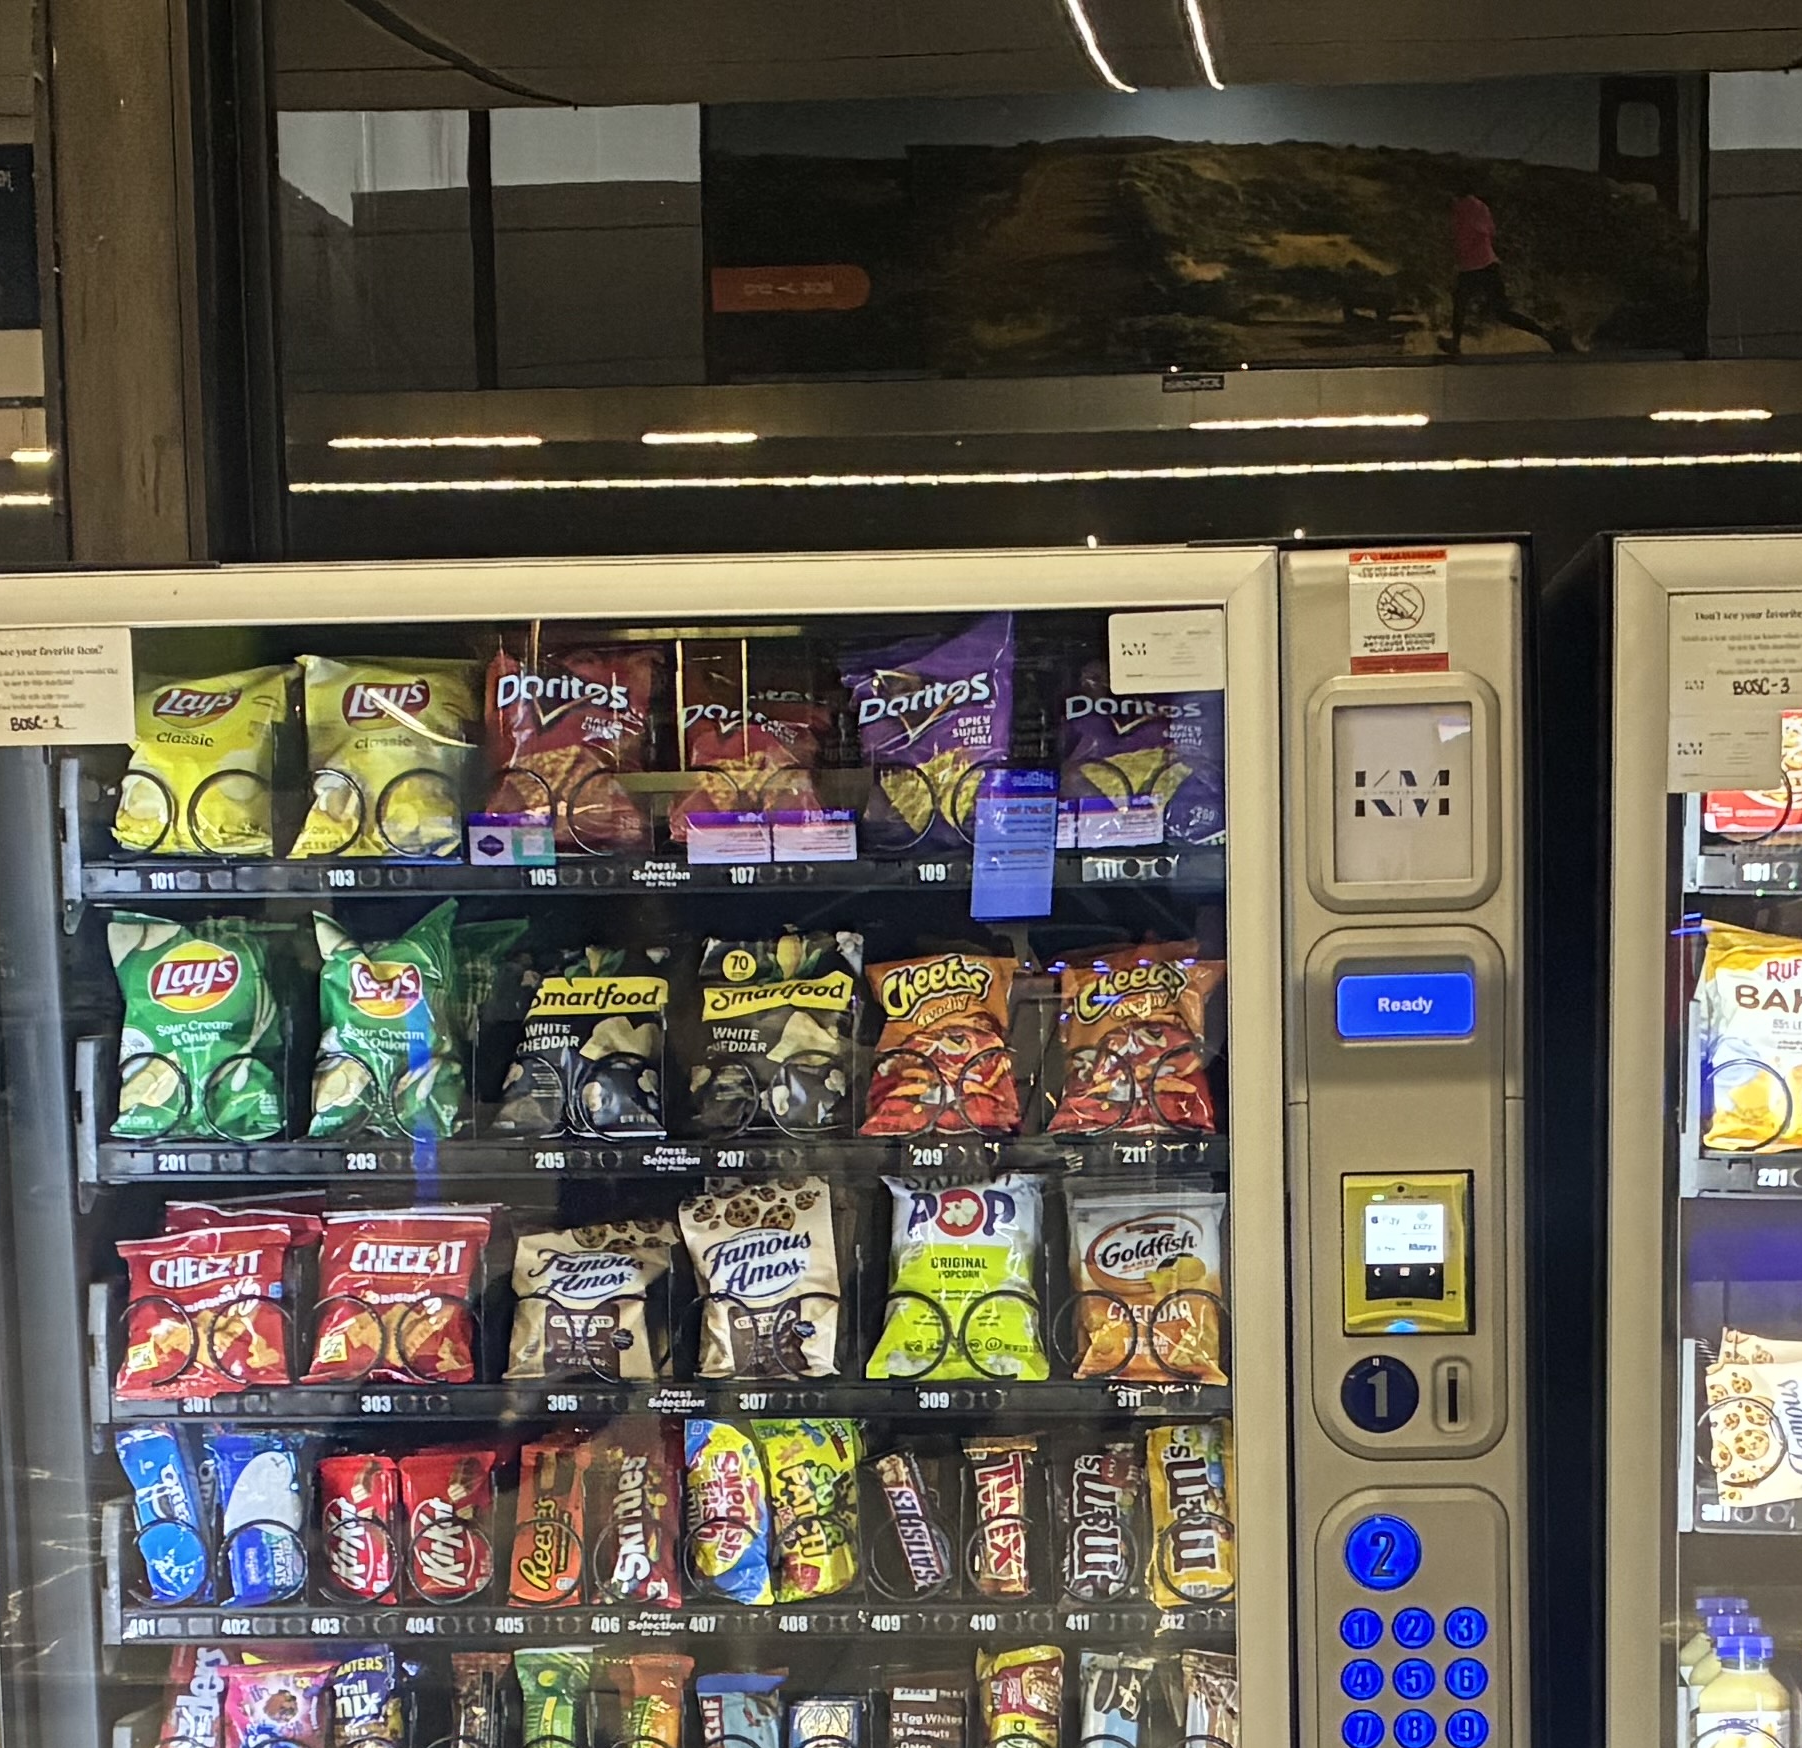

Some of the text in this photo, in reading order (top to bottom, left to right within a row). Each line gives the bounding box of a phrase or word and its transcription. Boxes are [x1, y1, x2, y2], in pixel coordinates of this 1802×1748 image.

[498, 674, 628, 709] Doritos
[859, 673, 990, 725] Doritos
[156, 731, 214, 749] Classic
[644, 861, 677, 870] Press
[149, 872, 175, 890] 101
[327, 870, 355, 888] 103
[530, 868, 556, 887] 105
[632, 870, 690, 881] Selection
[730, 955, 748, 971] 70
[155, 955, 239, 997] Lay's
[881, 955, 992, 1016] Cheetos
[531, 984, 657, 1010] Smartfood
[711, 982, 846, 1010] Smartfood
[1378, 996, 1433, 1014] Ready
[155, 1022, 232, 1036] Sour Cream
[712, 1028, 760, 1041] WHITE
[158, 1154, 186, 1172] 201
[346, 1153, 377, 1171] 203
[717, 1151, 745, 1168] 207
[703, 1229, 811, 1274] Famous
[1101, 1231, 1196, 1269] Goldfish
[930, 1256, 988, 1270] ORIGINAL
[724, 1257, 807, 1295] Amos
[938, 1269, 979, 1279] POPCORN
[919, 1391, 949, 1410] 309
[1367, 1369, 1388, 1417] 1
[362, 1395, 392, 1412] 303
[1370, 1531, 1396, 1577] 2
[311, 1617, 339, 1635] 403
[689, 1615, 716, 1633] 407
[1404, 1616, 1421, 1641] 2
[1458, 1616, 1473, 1641] 3
[1404, 1667, 1422, 1693] 5
[1458, 1666, 1474, 1692] 6
[334, 1682, 368, 1697] Trail
[902, 1712, 963, 1725] Egg Whites
